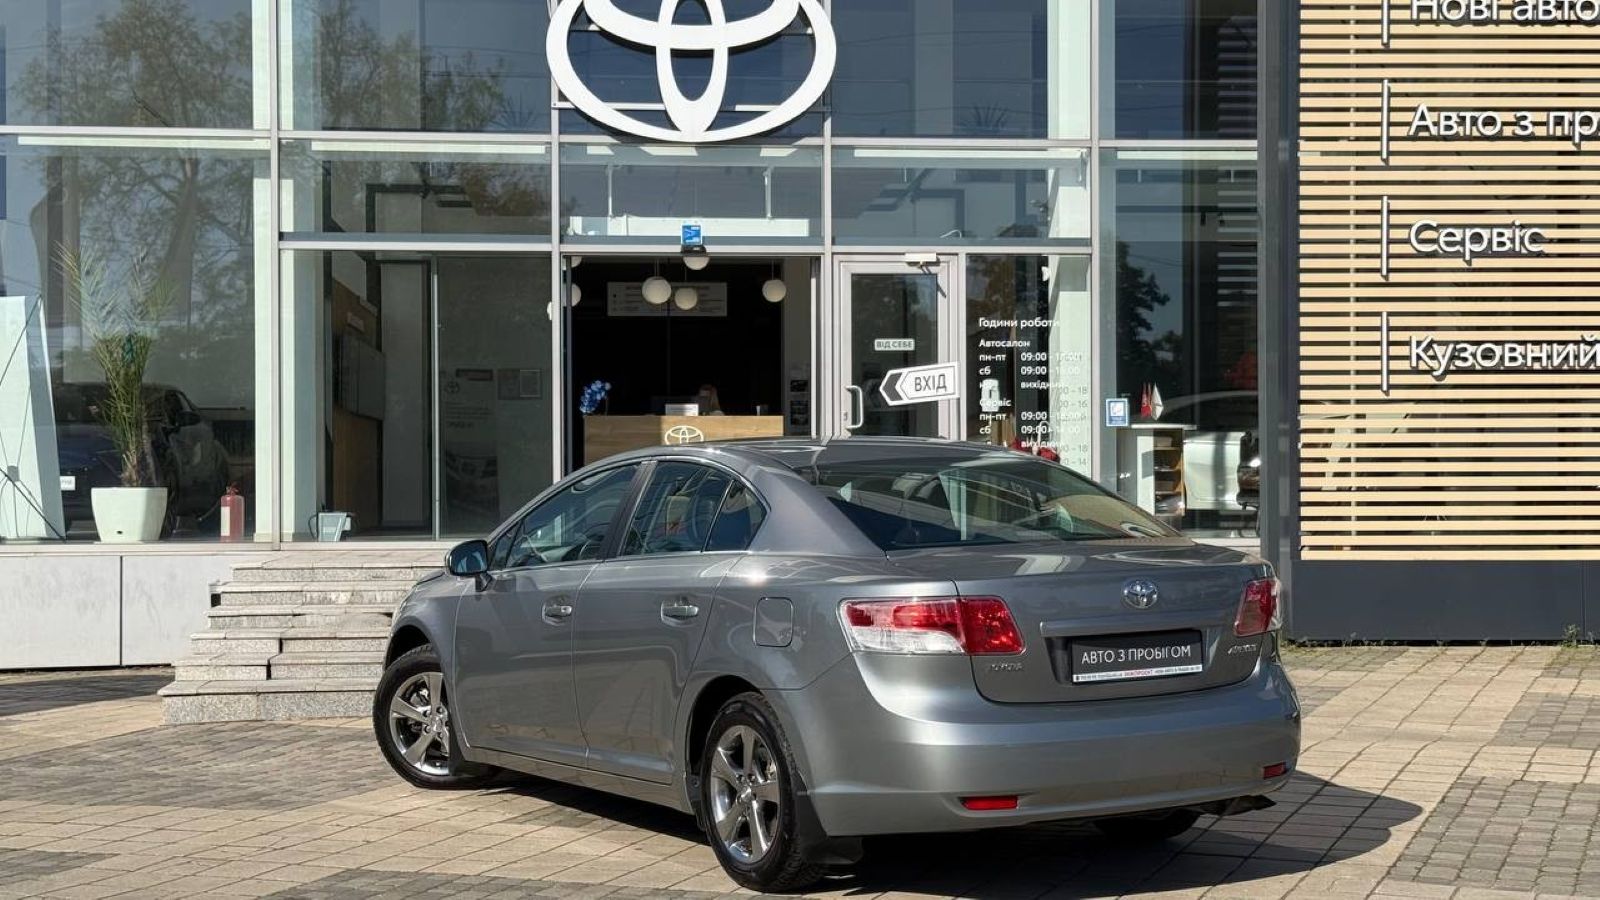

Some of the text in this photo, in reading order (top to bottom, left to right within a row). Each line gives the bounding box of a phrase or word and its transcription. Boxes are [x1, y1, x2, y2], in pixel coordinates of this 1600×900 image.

[1411, 0, 1600, 21] Нові авто
[1409, 103, 1501, 136] Авто
[1514, 111, 1533, 136] з
[1410, 219, 1545, 261] Сервіс
[979, 317, 1017, 329] Години
[979, 338, 1031, 348] Автосалон
[1020, 352, 1047, 362] 09:00
[1410, 334, 1600, 376] Кузовний
[979, 365, 991, 376] сб
[1020, 365, 1047, 375] 09:00
[914, 373, 947, 394] ВХІД
[1020, 380, 1063, 390] вихідн
[979, 413, 1007, 421] пн-пт
[1020, 411, 1048, 421] 09:00
[979, 425, 991, 434] сб
[1020, 425, 1047, 434] 09:00
[1081, 645, 1191, 664] АВТО З ПРОБІГОМ
